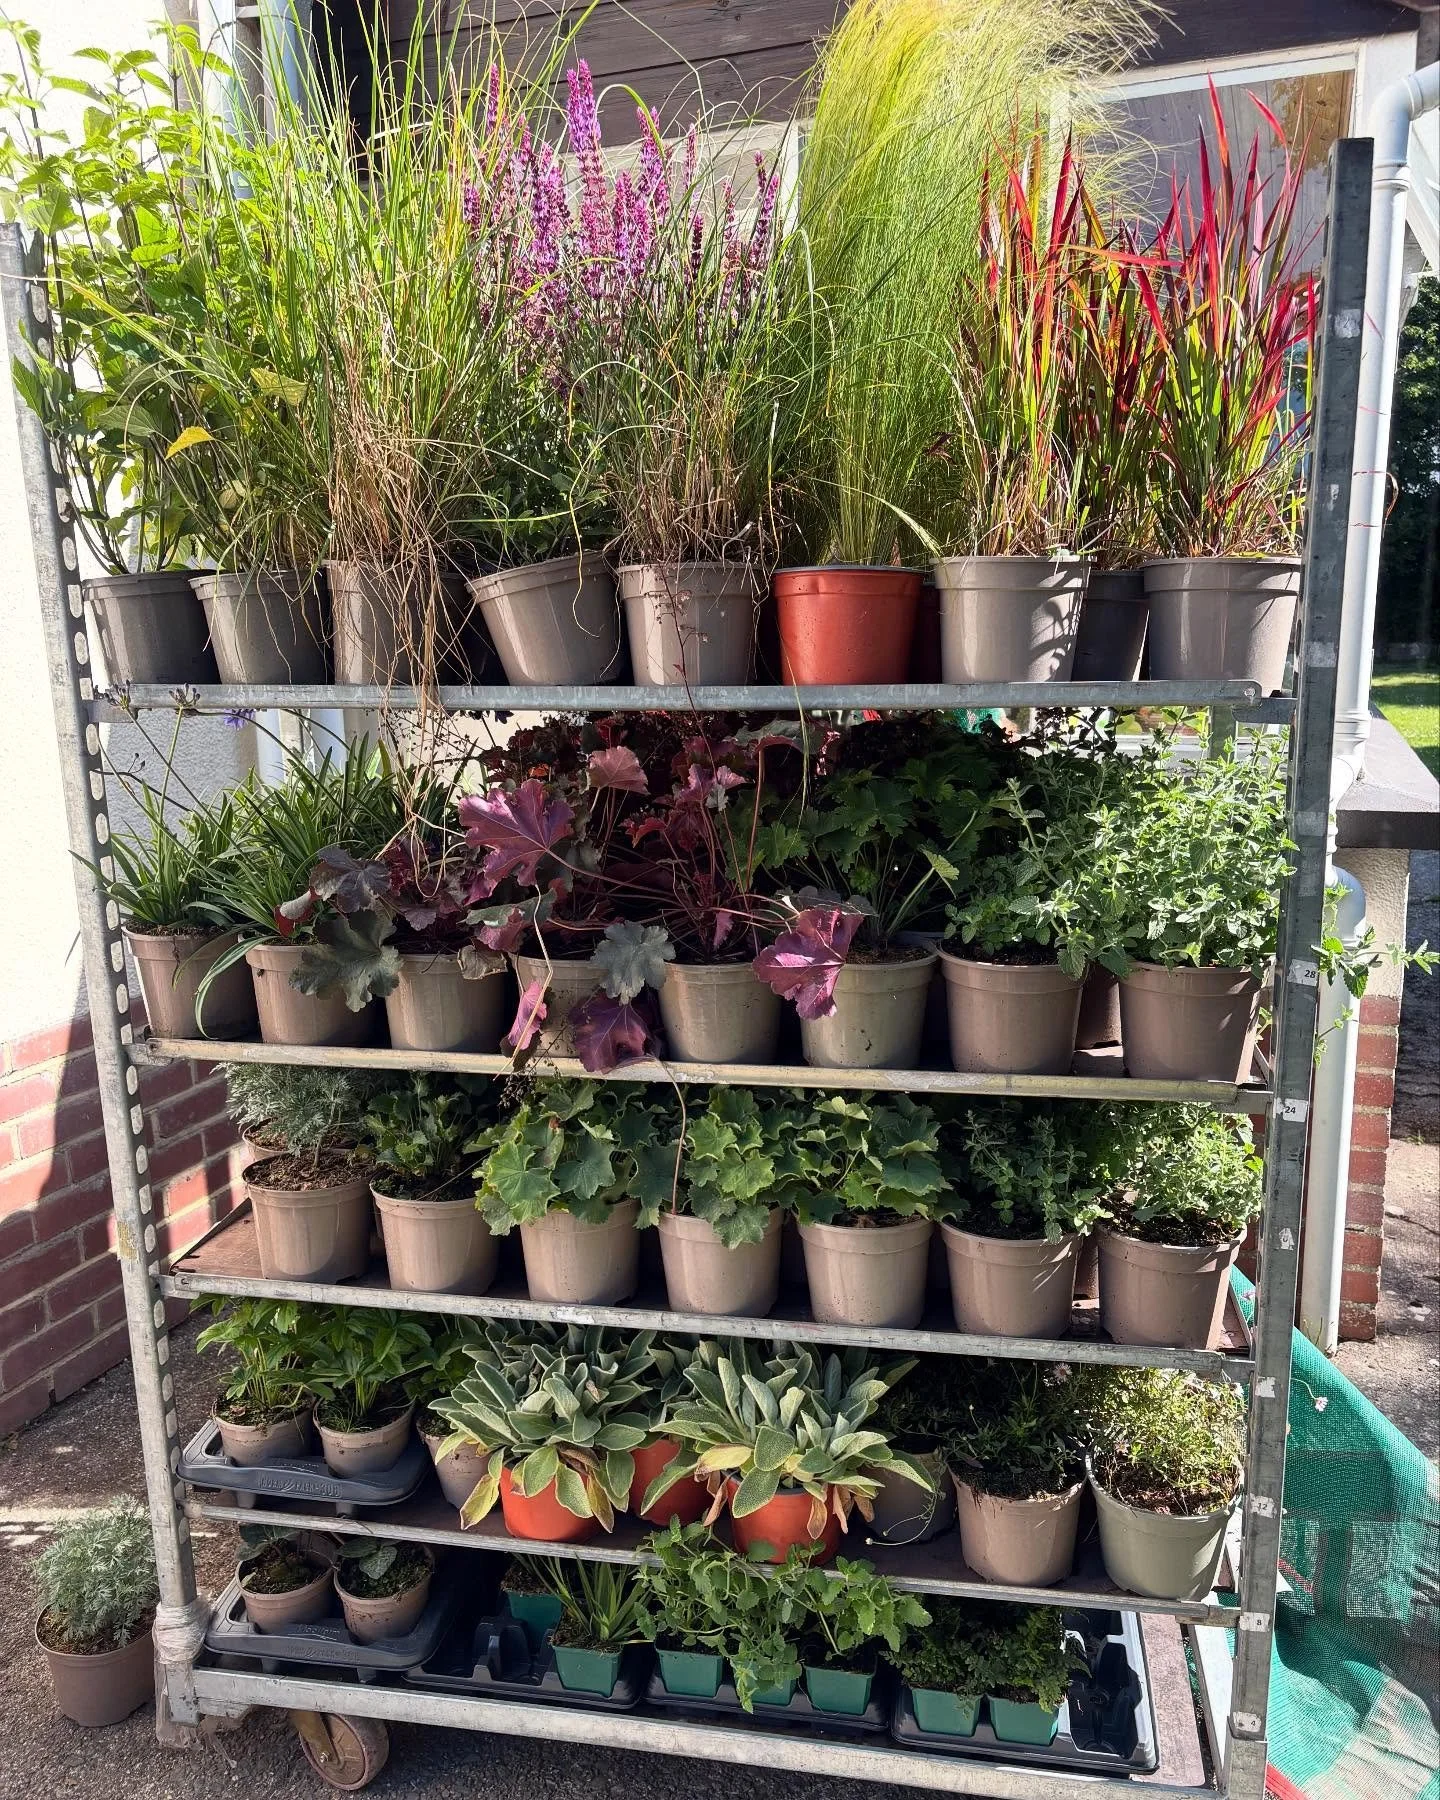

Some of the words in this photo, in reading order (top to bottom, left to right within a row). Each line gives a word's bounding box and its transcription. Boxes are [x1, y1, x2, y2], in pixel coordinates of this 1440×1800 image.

[1304, 969, 1316, 979] 28
[1284, 1106, 1296, 1114] 24
[1257, 1503, 1268, 1511] 12
